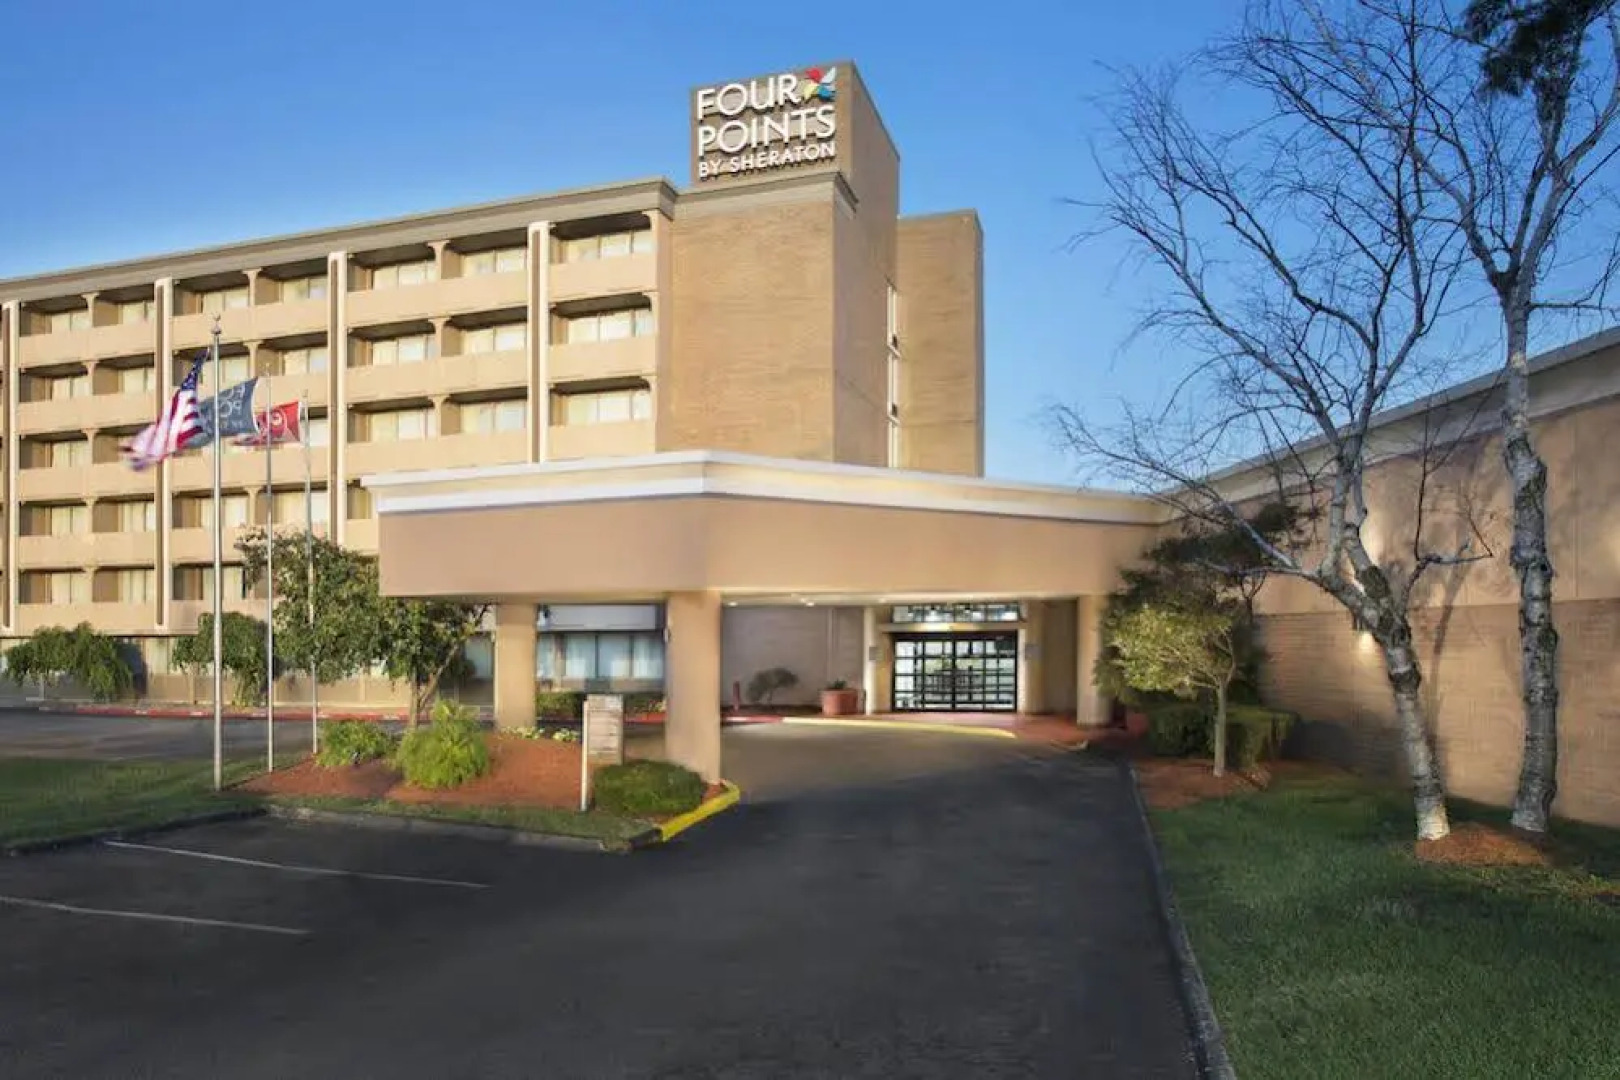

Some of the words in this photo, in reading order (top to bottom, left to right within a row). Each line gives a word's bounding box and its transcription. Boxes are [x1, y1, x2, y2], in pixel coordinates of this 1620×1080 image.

[697, 74, 801, 120] FOUR
[698, 104, 836, 157] POINTS
[699, 158, 722, 178] BY
[730, 141, 836, 173] SHERATON
